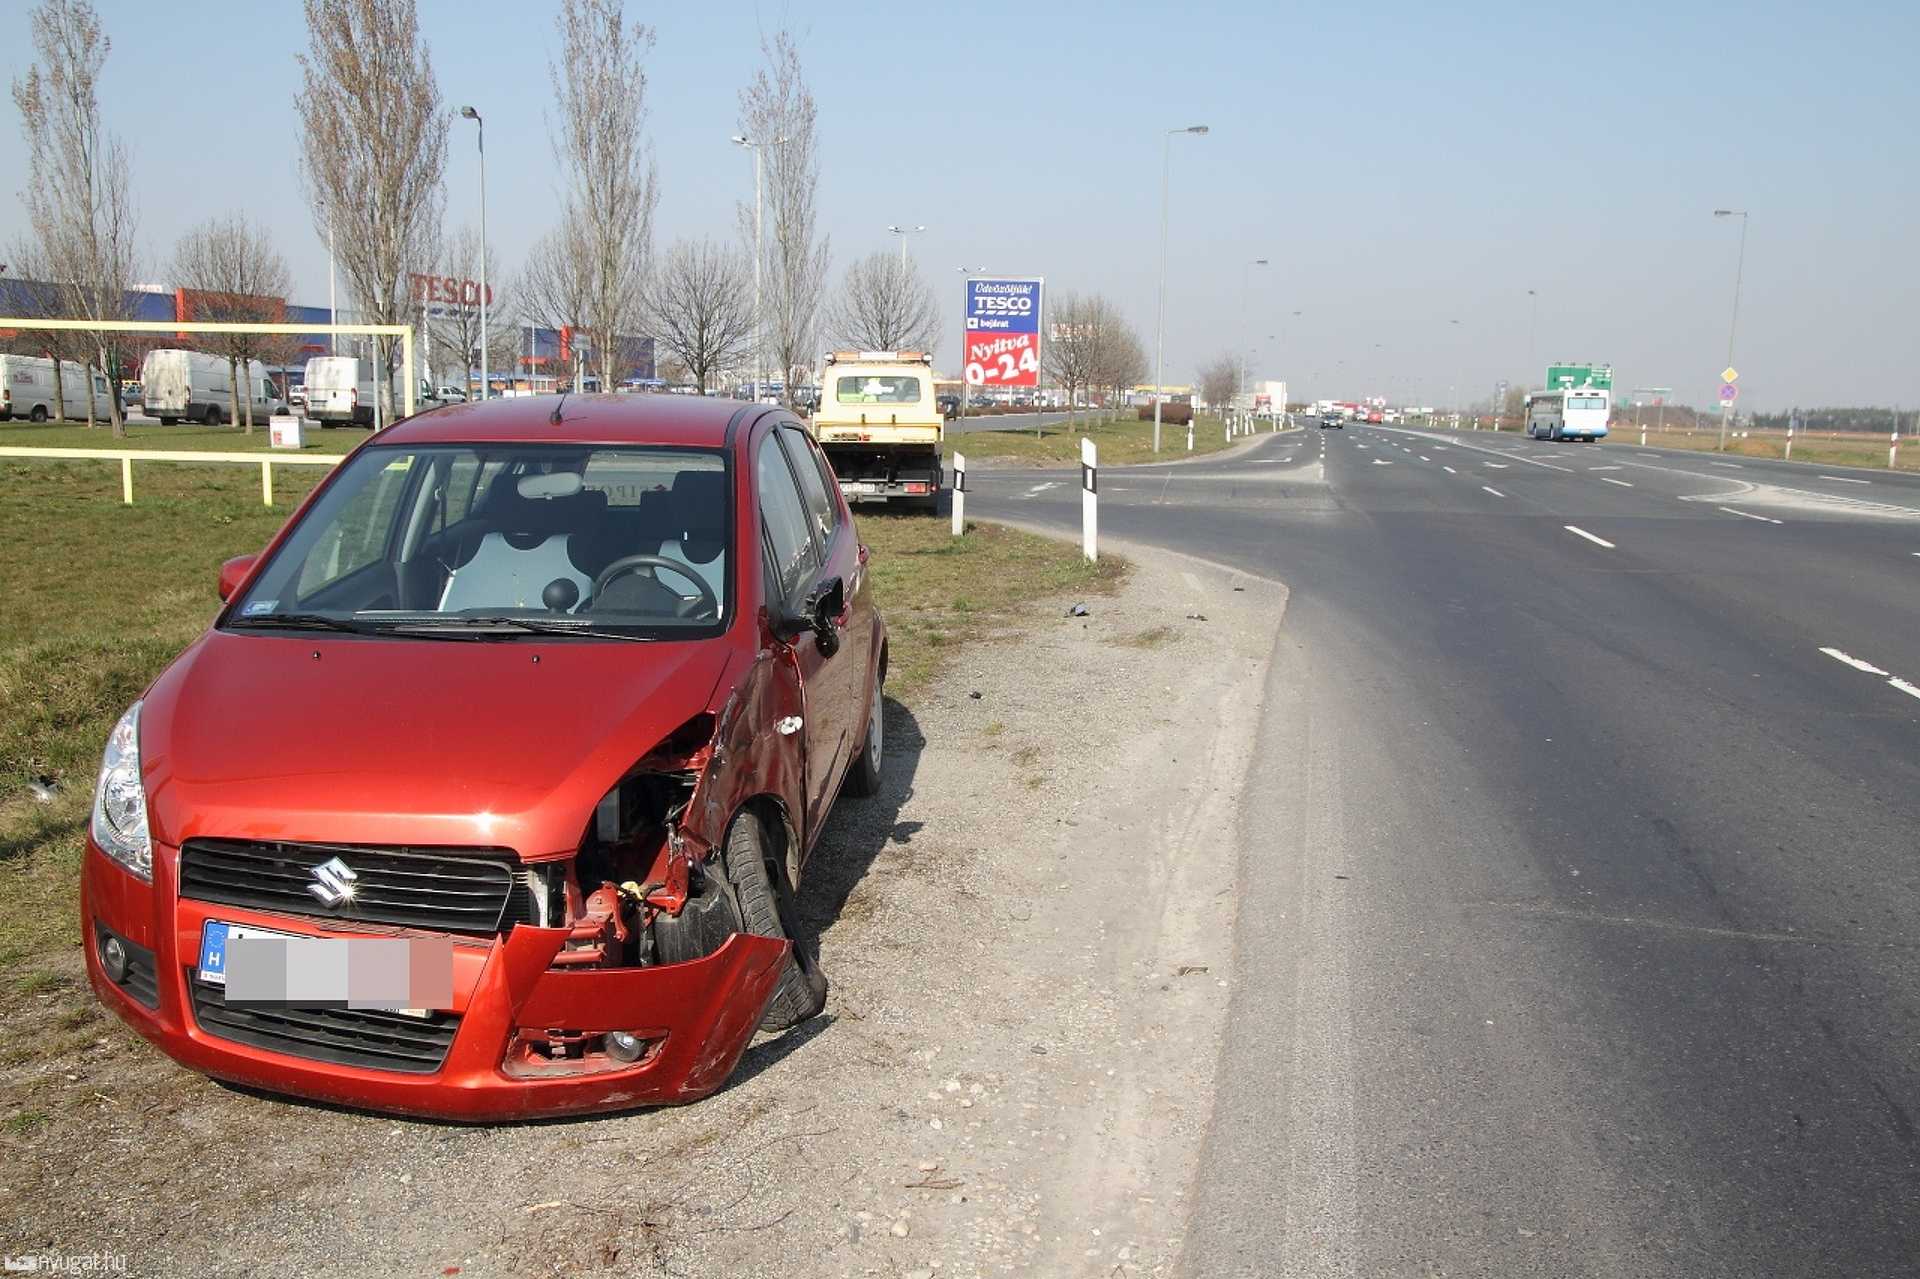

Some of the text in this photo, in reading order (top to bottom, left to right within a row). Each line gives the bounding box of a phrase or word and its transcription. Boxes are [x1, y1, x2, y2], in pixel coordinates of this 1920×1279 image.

[408, 272, 493, 306] TESCO
[974, 296, 1032, 310] TESCO
[970, 333, 1030, 361] Nyitva
[965, 347, 1038, 386] 0-24
[208, 951, 221, 966] H
